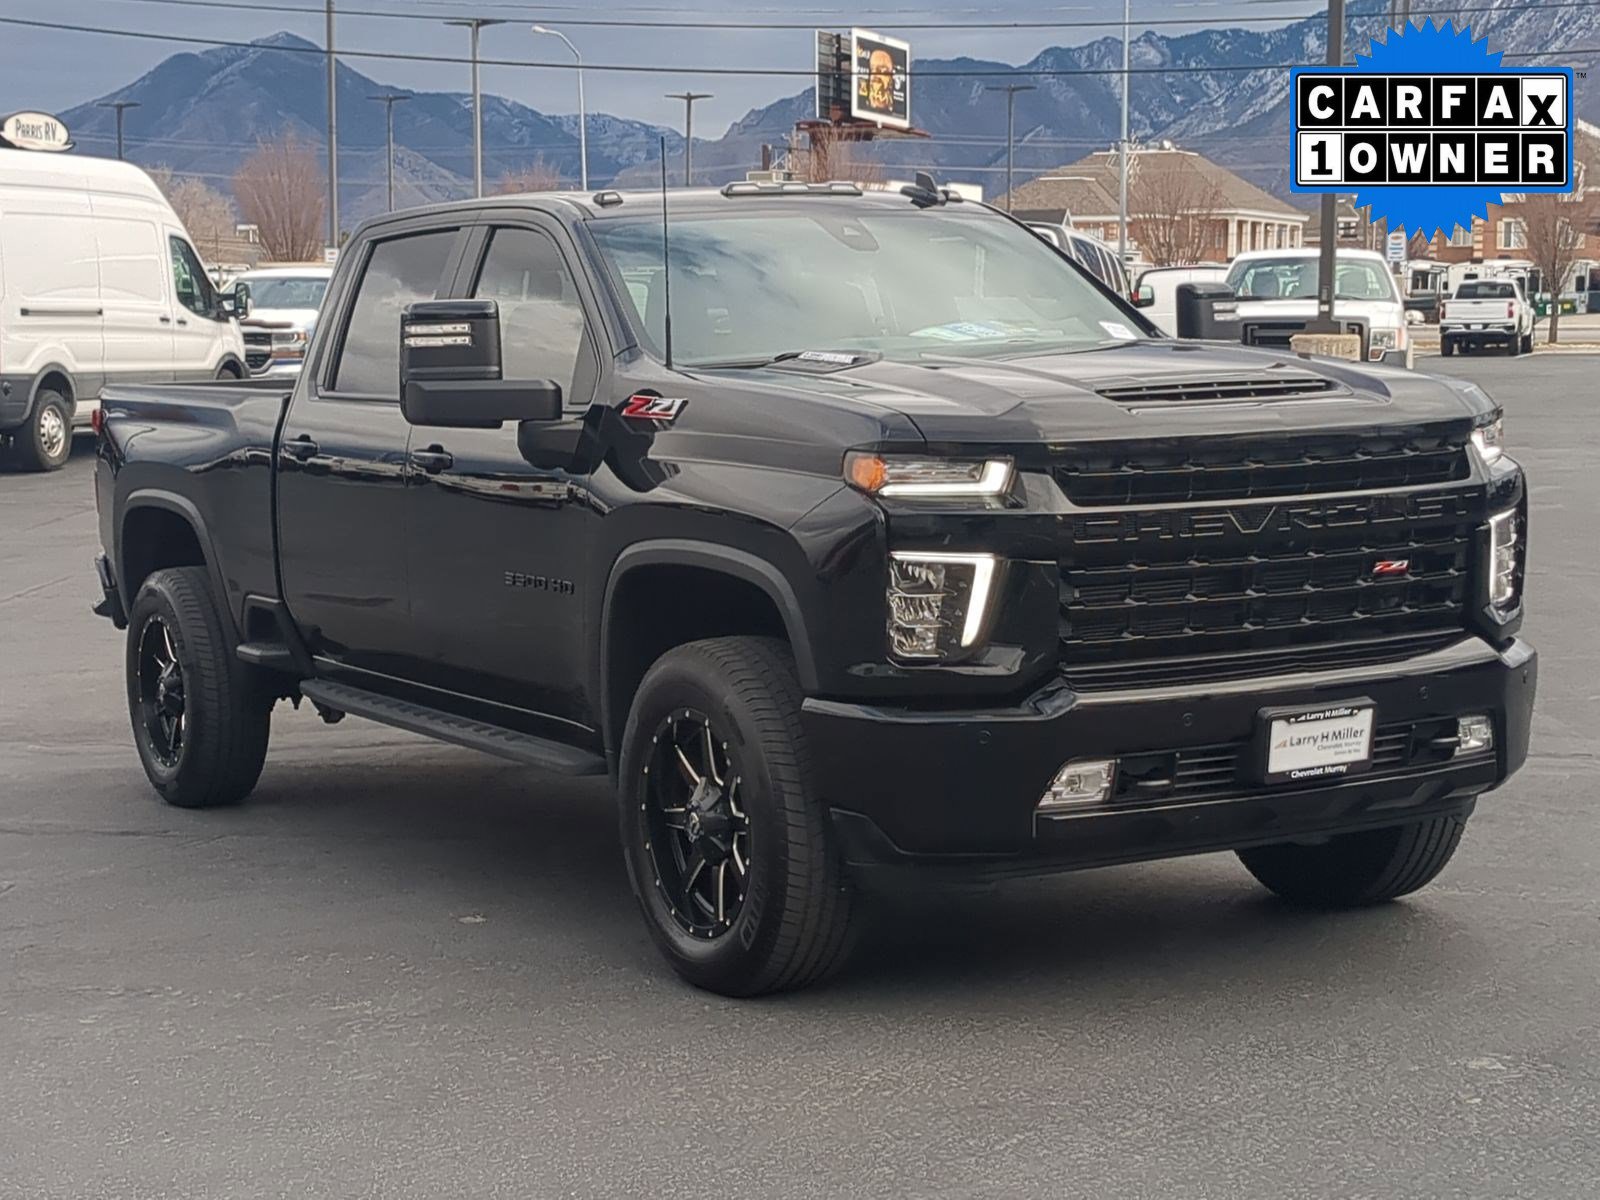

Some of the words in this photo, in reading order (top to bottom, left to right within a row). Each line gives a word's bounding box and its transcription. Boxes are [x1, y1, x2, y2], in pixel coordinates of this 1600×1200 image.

[44, 121, 58, 141] RV
[620, 394, 688, 420] Z71
[1073, 492, 1480, 543] CHEVROLET
[1290, 734, 1319, 747] Larry
[1321, 732, 1329, 742] H
[1331, 728, 1365, 740] Miller
[1291, 767, 1323, 779] Chevrolet
